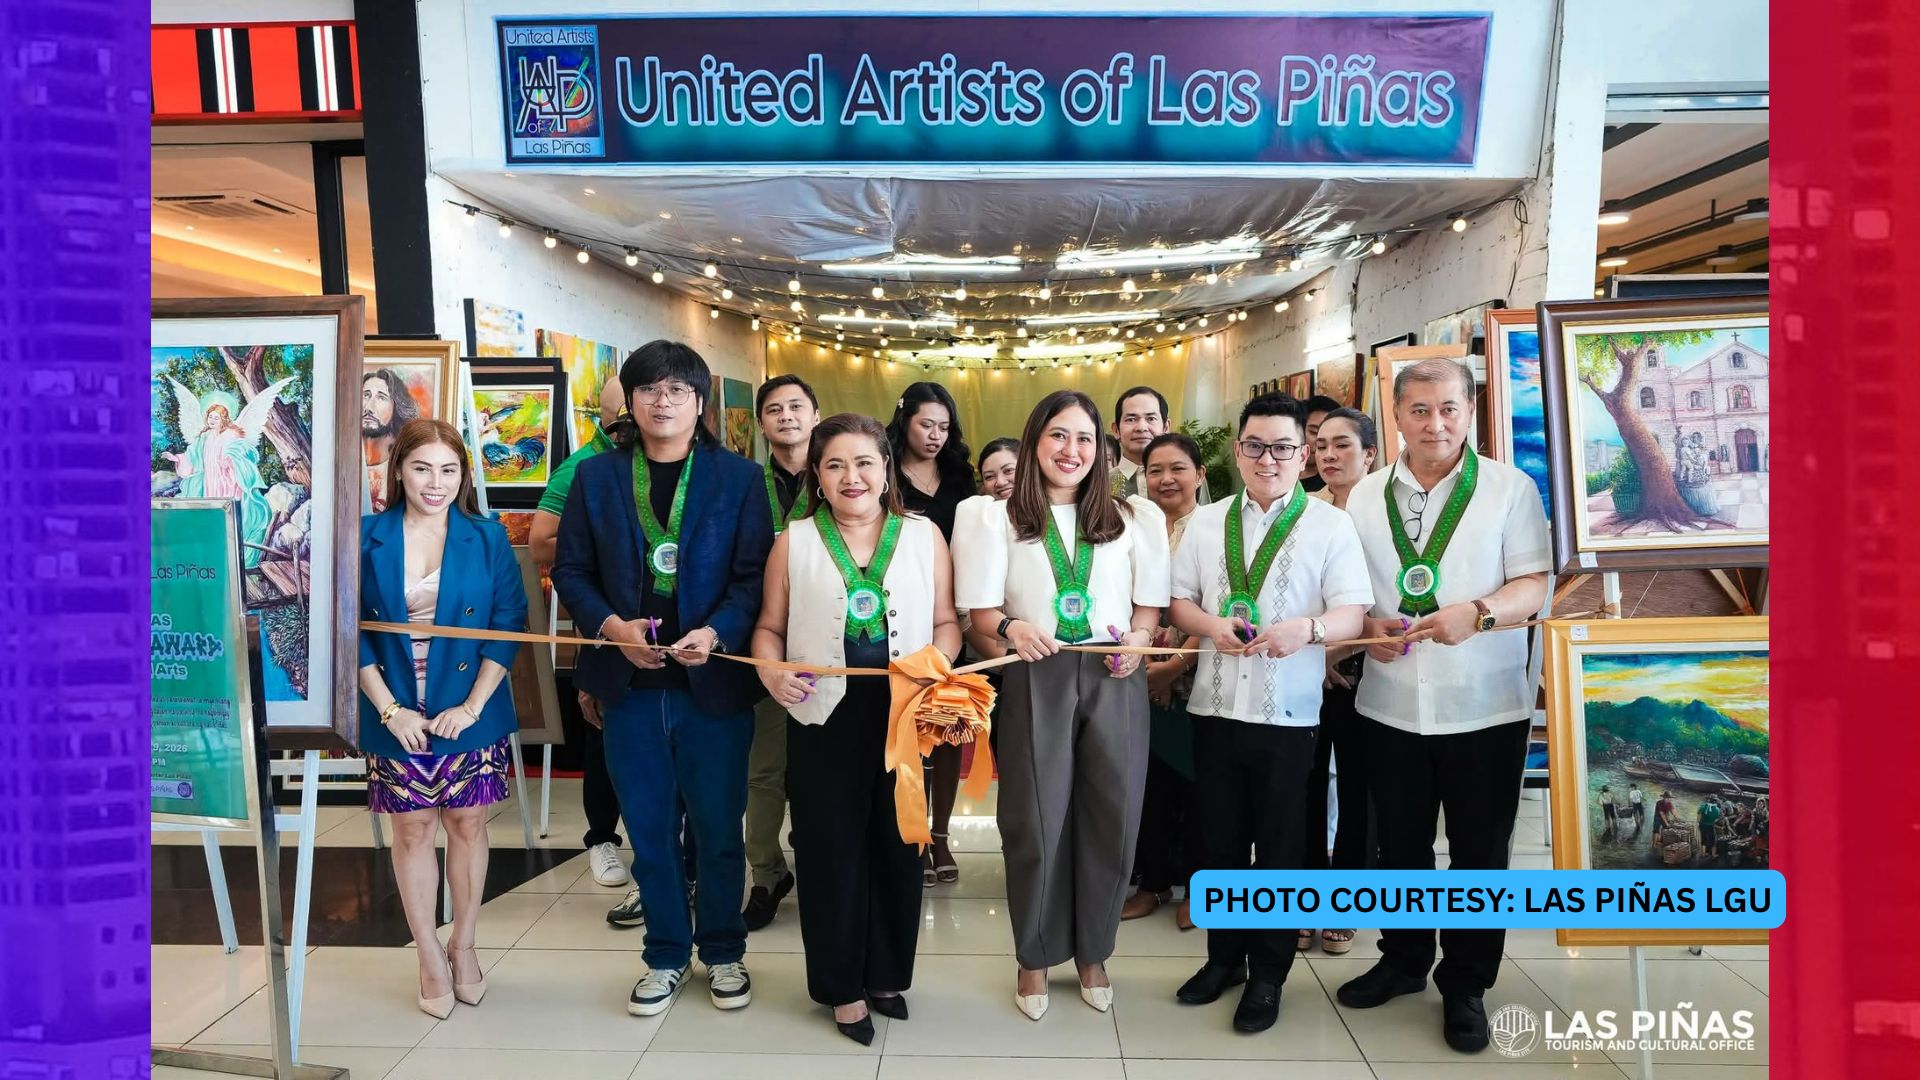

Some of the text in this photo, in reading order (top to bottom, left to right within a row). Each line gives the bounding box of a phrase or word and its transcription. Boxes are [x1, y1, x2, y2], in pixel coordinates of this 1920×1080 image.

[506, 28, 594, 44] United Artists
[615, 52, 1455, 127] United Artists of Las Piñas
[527, 119, 543, 134] of
[525, 139, 591, 154] Las Piñas
[176, 563, 216, 580] Piñas
[156, 663, 187, 677] Arts
[164, 743, 188, 753] 2026
